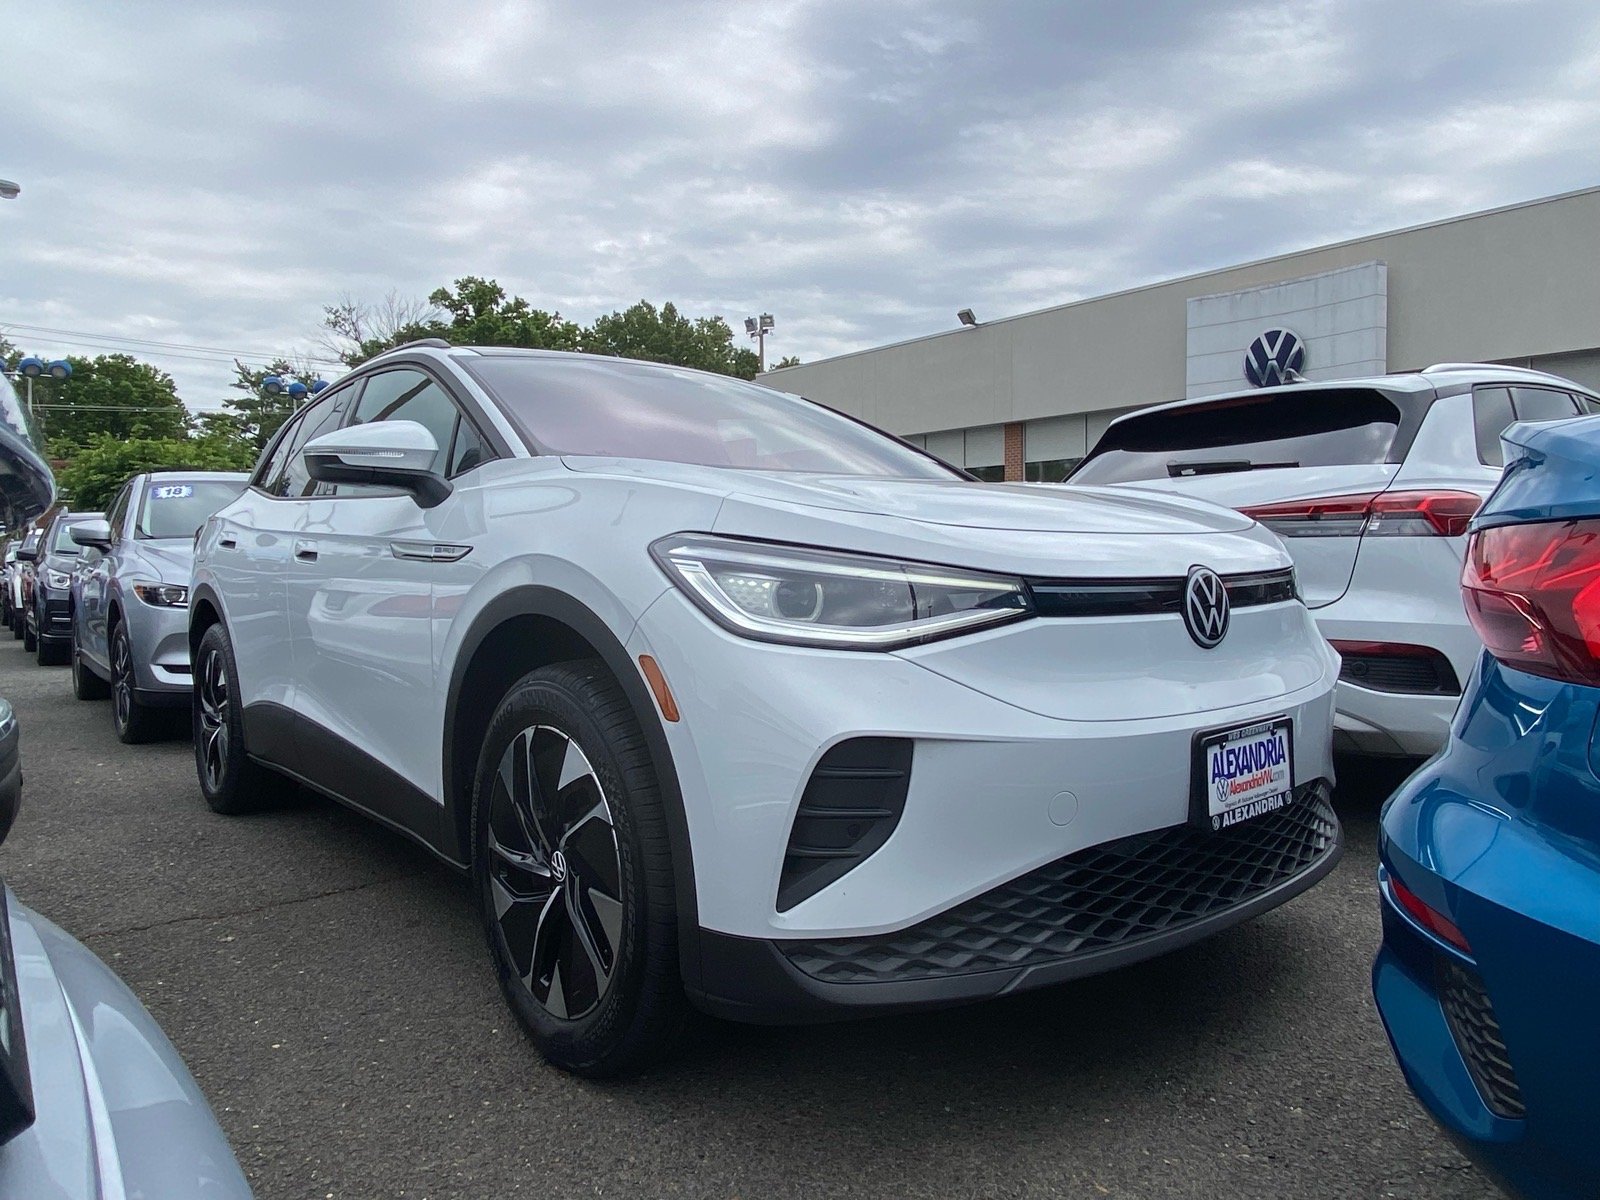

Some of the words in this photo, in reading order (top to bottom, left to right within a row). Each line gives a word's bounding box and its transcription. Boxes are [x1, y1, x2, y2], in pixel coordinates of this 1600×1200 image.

[1245, 328, 1304, 387] VW
[1187, 568, 1229, 645] VW
[1212, 736, 1286, 784] ALEXANDRIA
[1222, 794, 1284, 828] ALEXANDRIA
